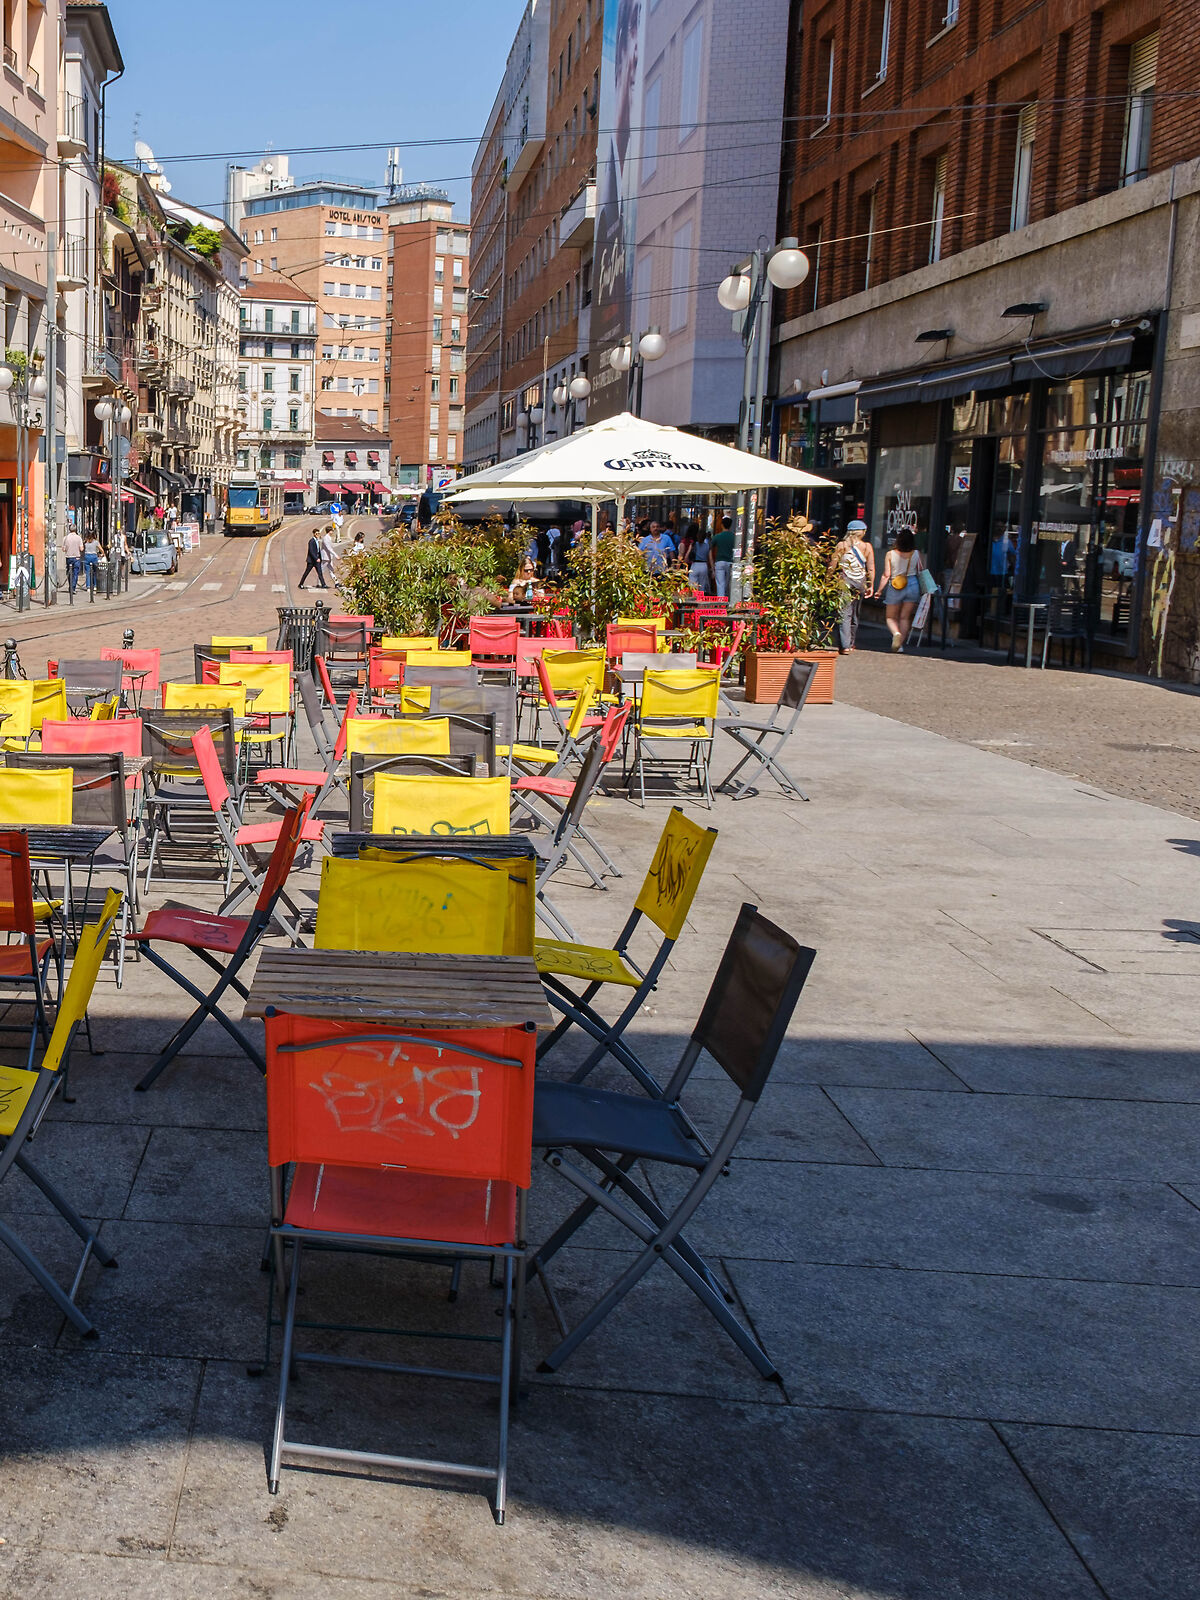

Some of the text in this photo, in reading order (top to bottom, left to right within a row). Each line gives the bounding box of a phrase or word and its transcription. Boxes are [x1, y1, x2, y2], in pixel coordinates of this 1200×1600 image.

[329, 209, 381, 225] HOTEL ARISTON
[1089, 448, 1111, 460] COCKTAIL
[1112, 447, 1124, 458] BAR
[603, 458, 706, 472] Corona
[896, 490, 912, 511] SAN
